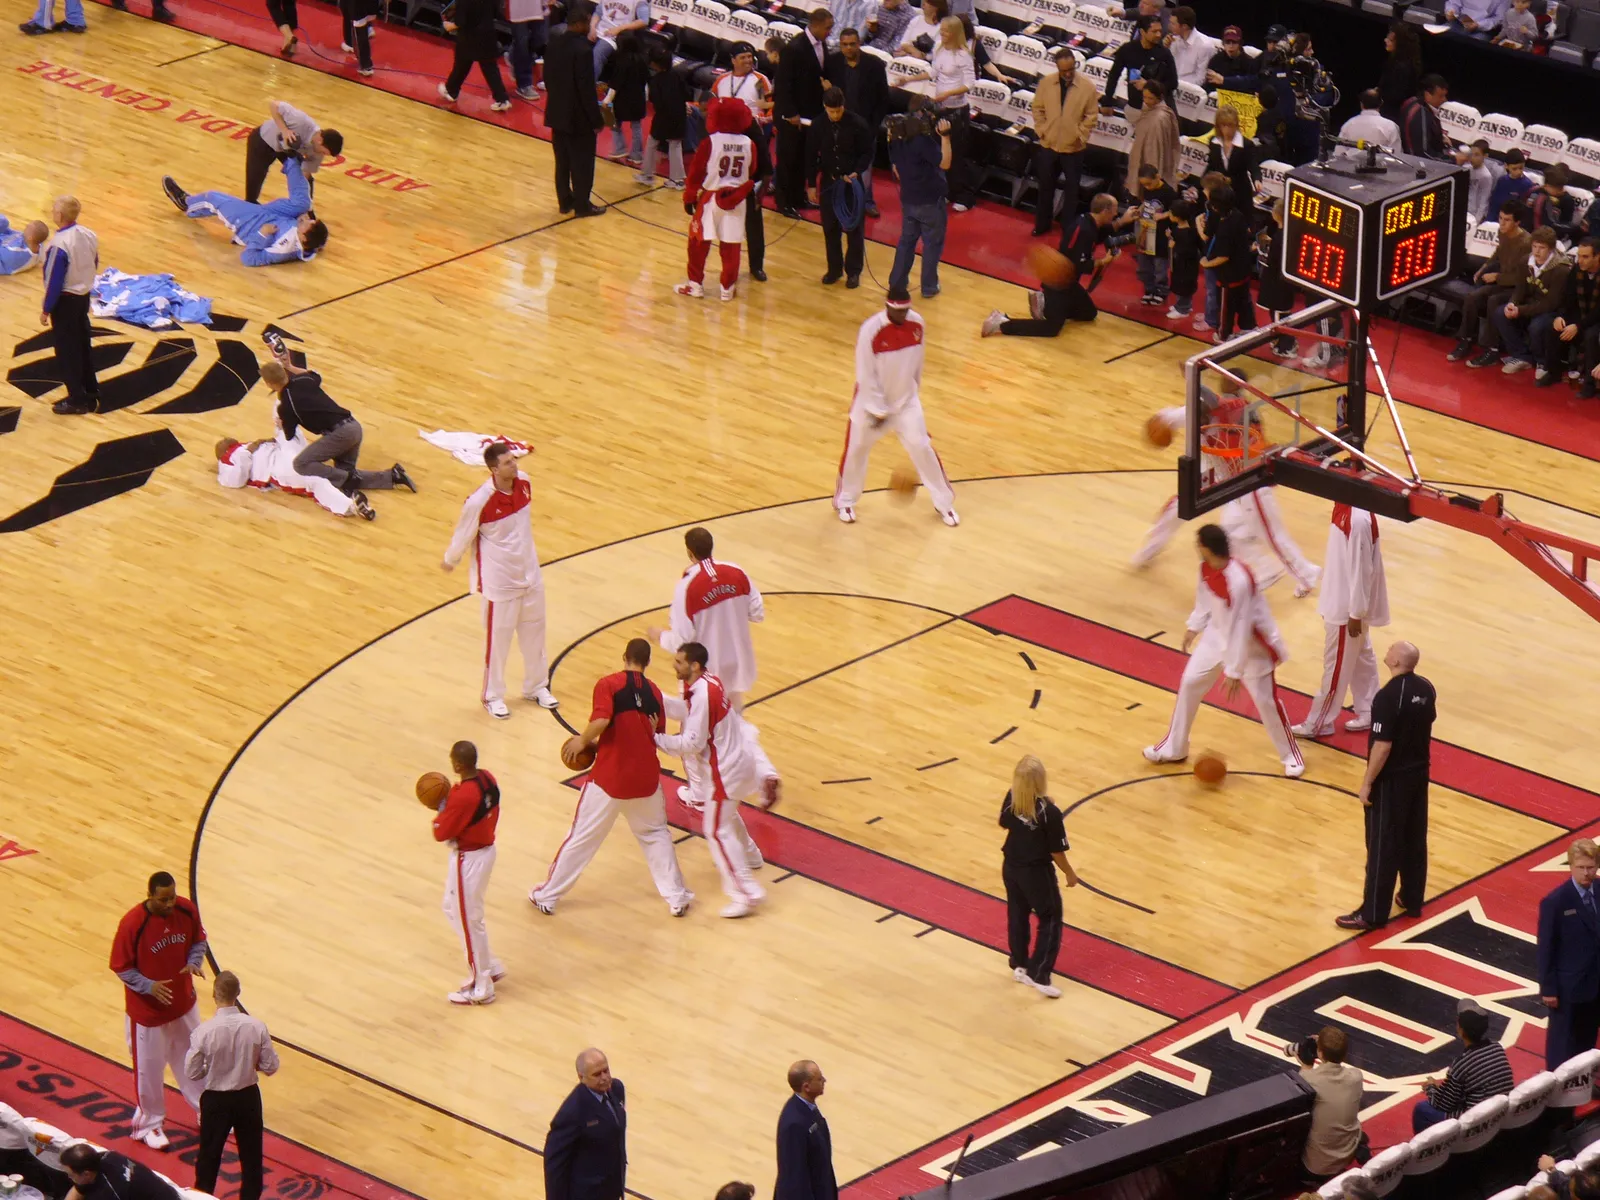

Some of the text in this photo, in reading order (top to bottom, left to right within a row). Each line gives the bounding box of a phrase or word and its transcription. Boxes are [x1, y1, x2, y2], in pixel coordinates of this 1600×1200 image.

[691, 4, 726, 22] FAN 590
[1033, 0, 1051, 12] FAN
[1051, 3, 1070, 15] 590
[728, 15, 763, 35] FAN 590
[1073, 10, 1091, 23] FAN
[1090, 15, 1110, 29] 590
[1110, 20, 1130, 33] FAN
[1005, 41, 1042, 60] FAN 590
[890, 61, 908, 74] FAN
[1084, 64, 1104, 78] FAN
[16, 60, 171, 112] CENTRE
[986, 89, 1006, 101] 590
[1009, 96, 1028, 110] FAN
[1183, 92, 1200, 105] 590
[1455, 113, 1475, 128] 590
[1478, 120, 1498, 134] FAN
[1498, 125, 1518, 138] 590
[1109, 124, 1128, 137] 590
[1521, 131, 1542, 145] FAN
[1543, 136, 1563, 150] 590
[1567, 143, 1586, 157] FAN
[718, 155, 745, 178] 95
[345, 164, 430, 192] AIR
[1474, 228, 1496, 242] FAN
[1298, 233, 1346, 289] 00
[1391, 229, 1438, 286] 00
[150, 933, 187, 954] RAPTORS
[1563, 1072, 1591, 1090] FAN
